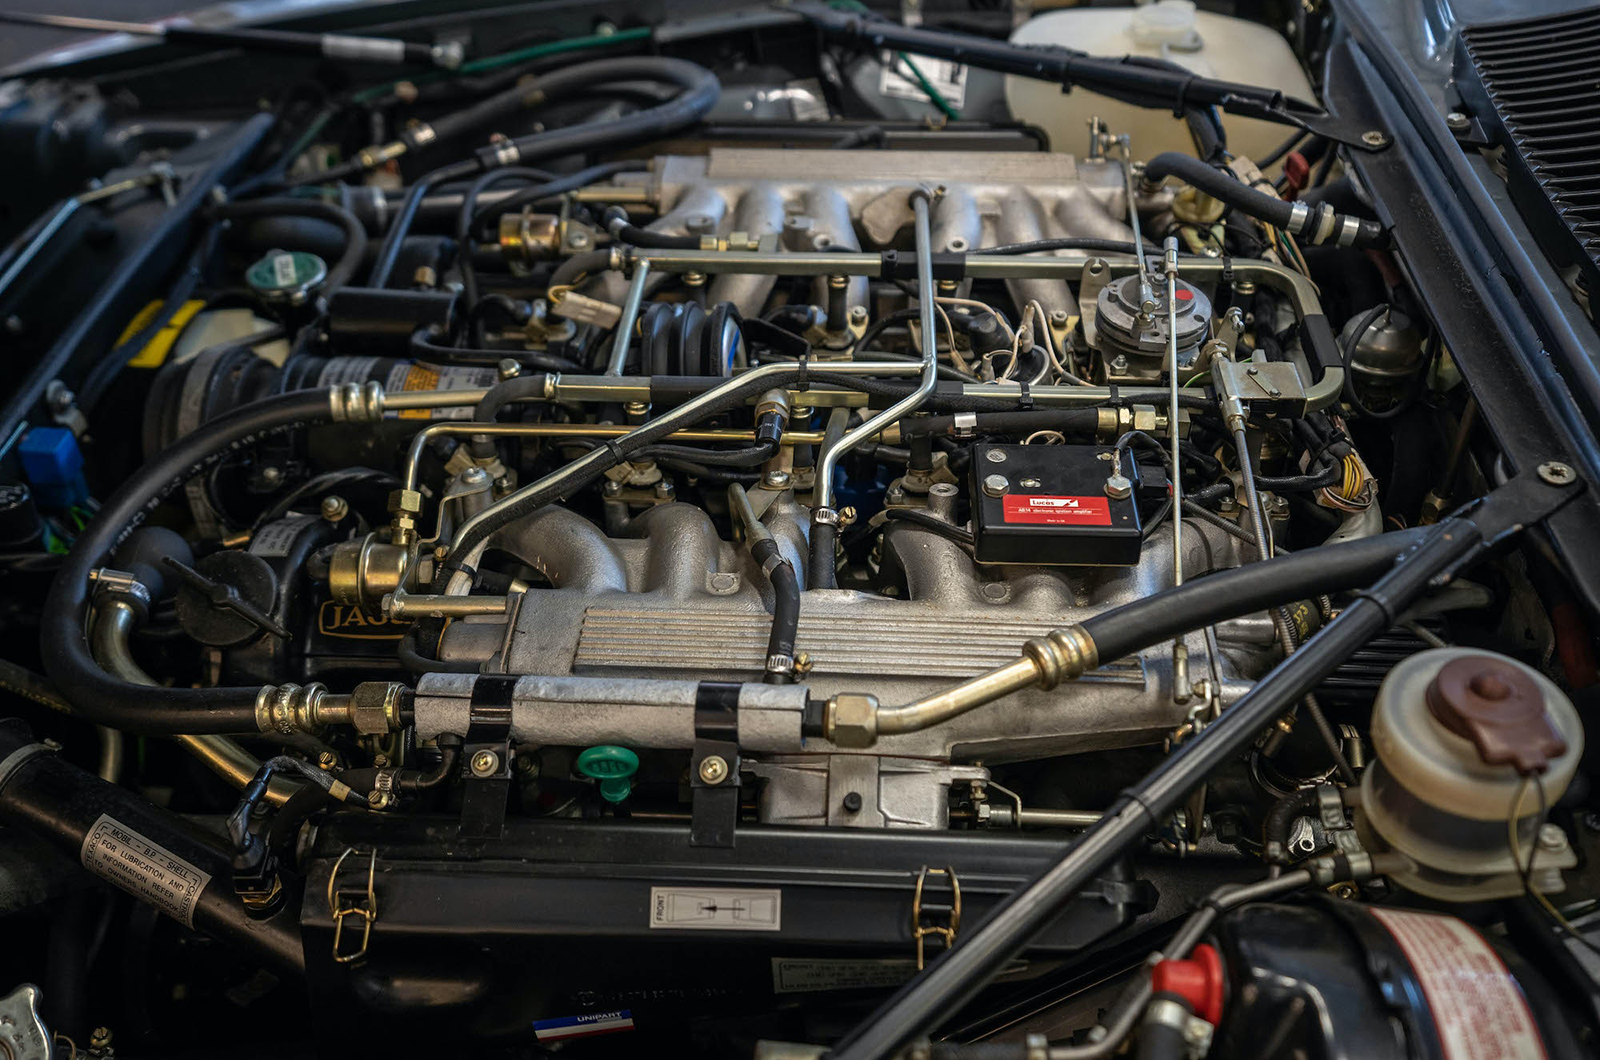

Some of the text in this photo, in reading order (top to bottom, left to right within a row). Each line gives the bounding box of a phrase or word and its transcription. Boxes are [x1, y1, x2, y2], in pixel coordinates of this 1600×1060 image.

[86, 832, 100, 863] TEXACO
[110, 828, 132, 845] MOBIL
[166, 861, 188, 878] SHELL
[94, 859, 103, 869] TO
[101, 839, 184, 891] FOR LUBRICATION AND
[102, 853, 148, 884] INFORMATION
[152, 883, 174, 899] REFER
[656, 895, 665, 921] FRONT
[577, 1011, 622, 1022] UNIPART
